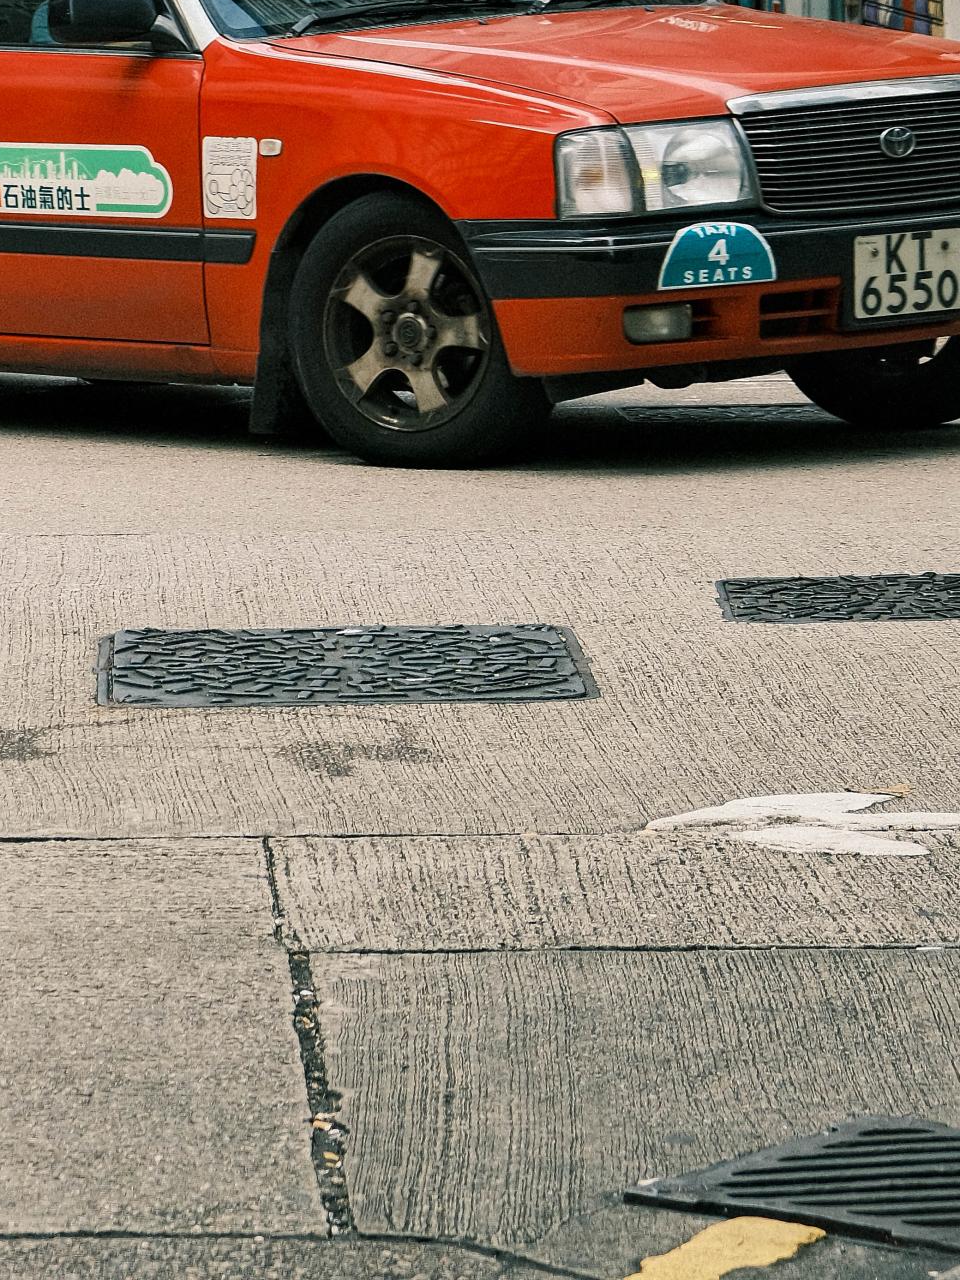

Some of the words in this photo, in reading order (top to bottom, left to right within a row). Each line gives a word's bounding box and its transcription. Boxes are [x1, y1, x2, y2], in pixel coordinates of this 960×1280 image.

[691, 224, 738, 238] TAXI
[707, 239, 730, 266] 4
[885, 231, 933, 274] KT
[683, 266, 753, 284] SEATS
[861, 269, 959, 316] 6550
